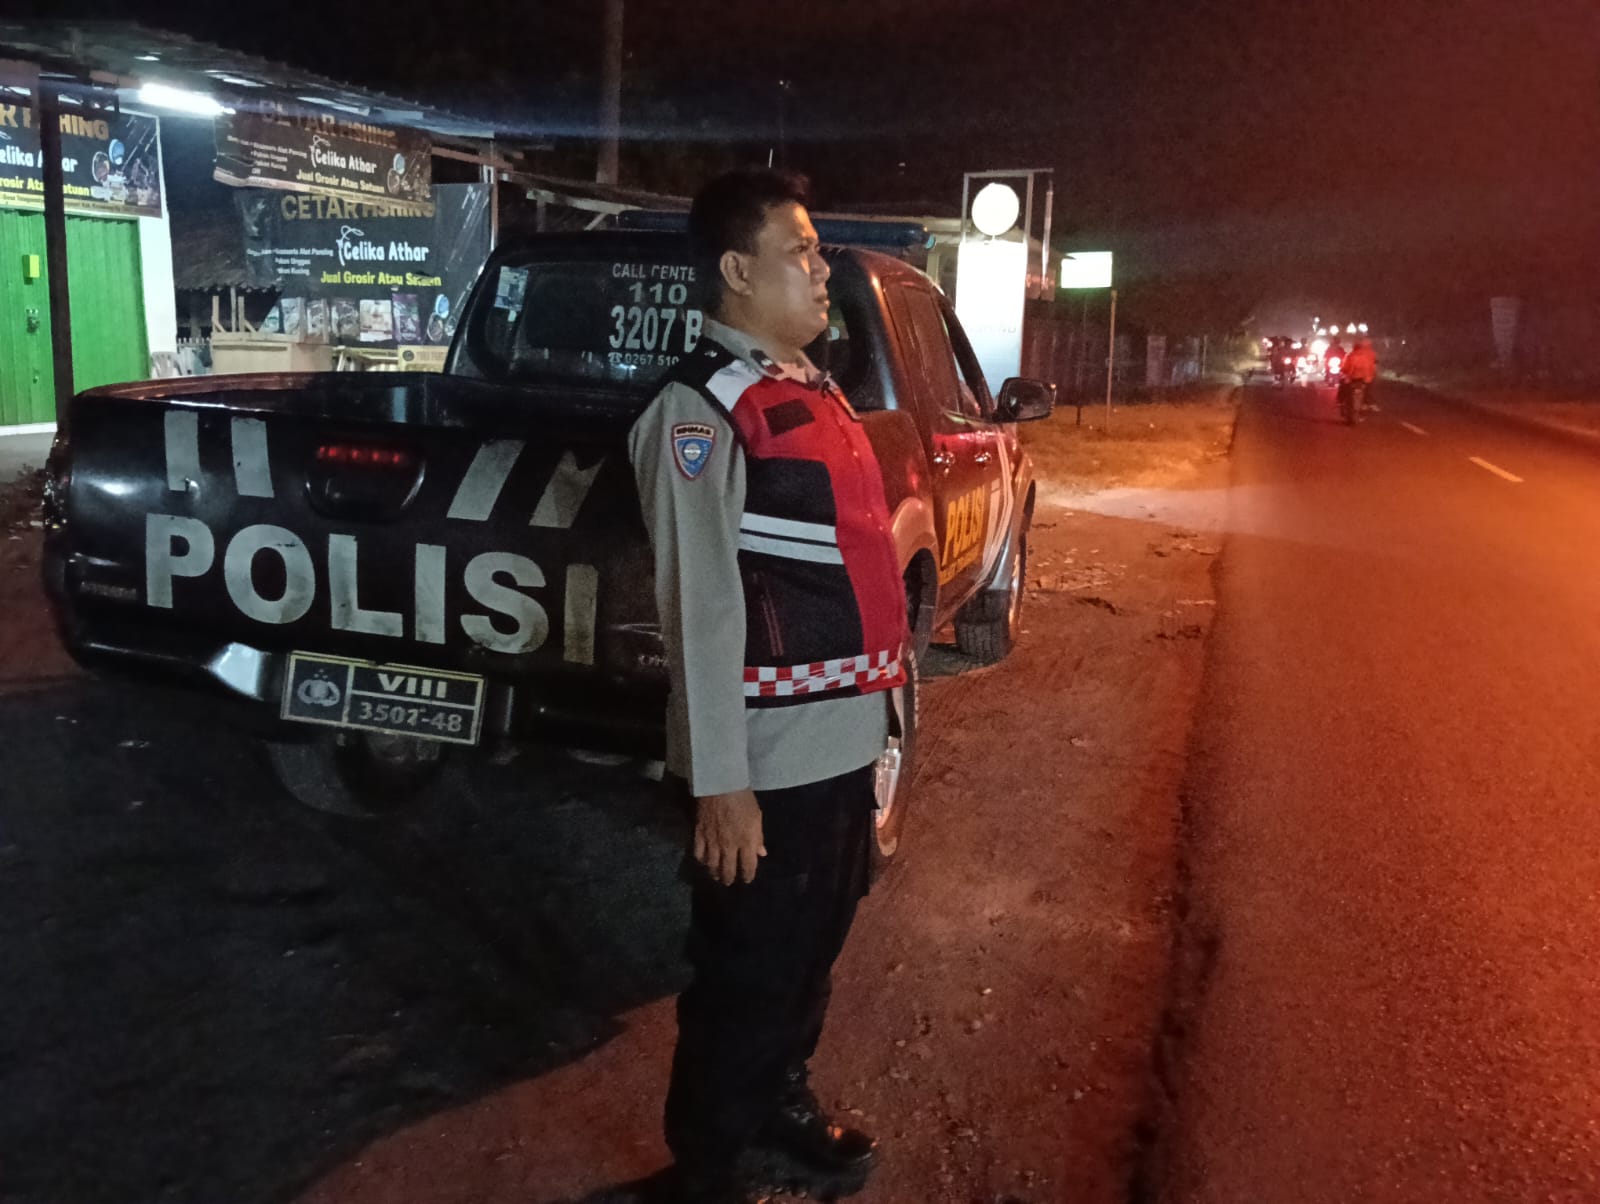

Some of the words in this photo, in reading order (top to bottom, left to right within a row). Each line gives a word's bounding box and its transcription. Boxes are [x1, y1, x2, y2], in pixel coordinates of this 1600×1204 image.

[0, 145, 33, 167] elika
[38, 150, 78, 172] Aar
[316, 148, 346, 168] Celika
[348, 155, 377, 174] Athar
[0, 176, 24, 190] rosir
[281, 194, 359, 220] CETAR
[344, 241, 385, 261] Celika
[389, 241, 429, 261] Athar
[321, 271, 341, 283] Jual
[344, 271, 376, 284] Grosir
[378, 272, 403, 285] Atau
[612, 263, 646, 278] CALL
[651, 264, 697, 282] CENTE
[629, 282, 688, 304] 110
[609, 305, 677, 352] 3207
[941, 484, 986, 567] POLISI
[145, 512, 599, 666] POLISI
[377, 673, 449, 699] VIII
